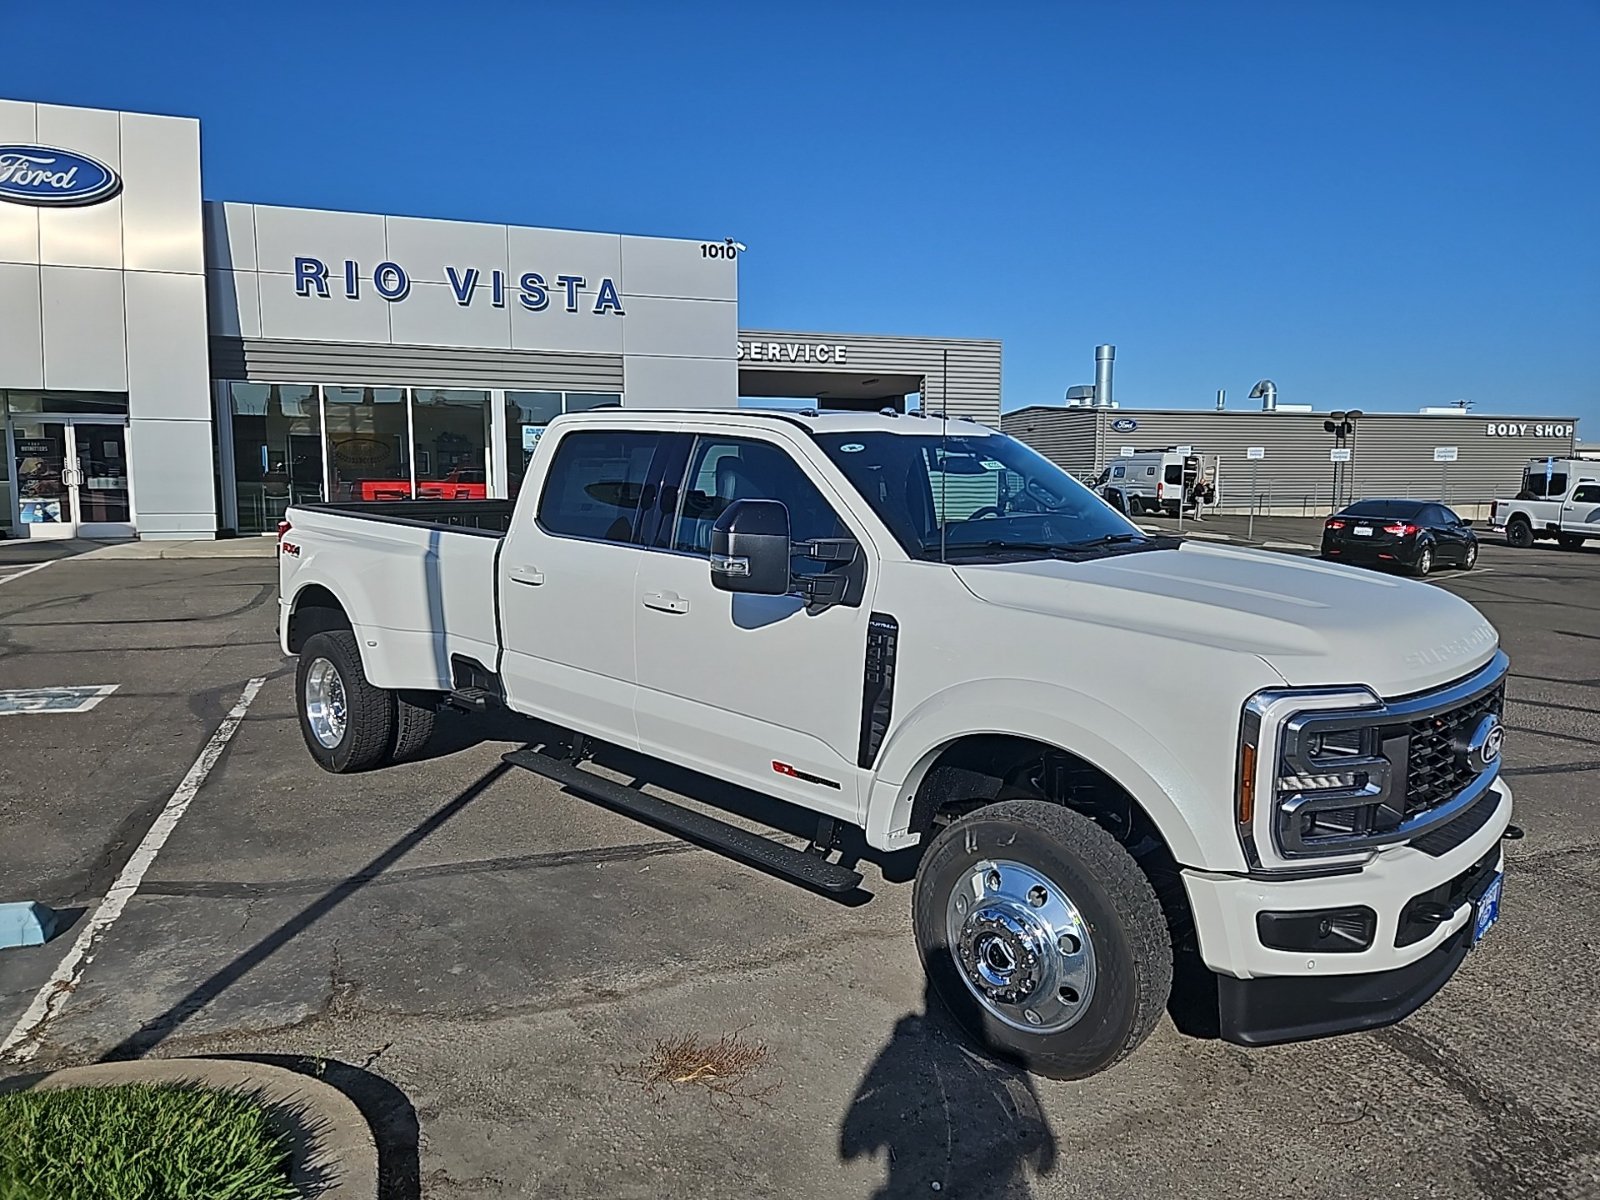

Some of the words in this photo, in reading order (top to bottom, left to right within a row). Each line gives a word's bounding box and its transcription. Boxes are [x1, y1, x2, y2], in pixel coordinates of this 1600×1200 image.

[0, 154, 78, 188] Ford
[701, 244, 736, 260] 1010
[294, 256, 410, 301] RIO
[444, 265, 625, 315] VISTA
[1117, 421, 1133, 429] Ford
[1487, 423, 1527, 437] BODY
[1535, 424, 1573, 437] SHOP
